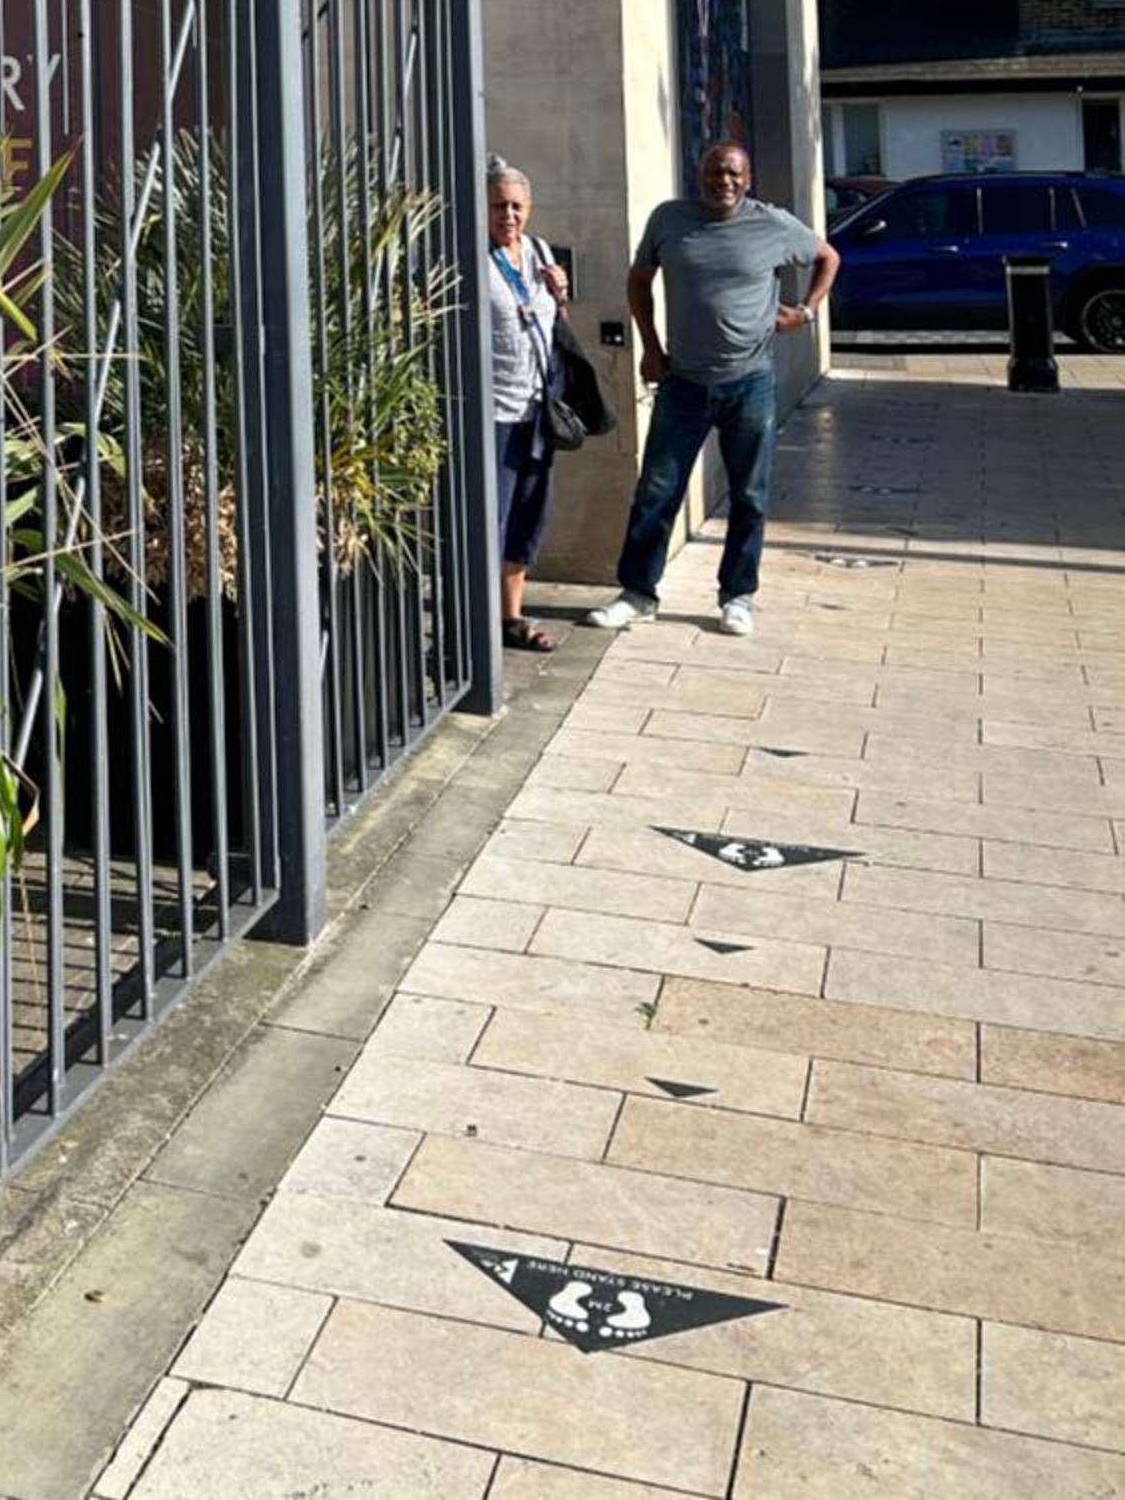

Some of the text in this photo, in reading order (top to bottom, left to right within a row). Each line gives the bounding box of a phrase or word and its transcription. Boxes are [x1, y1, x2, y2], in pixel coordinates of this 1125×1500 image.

[527, 1260, 694, 1300] PLEASE STAND HERE
